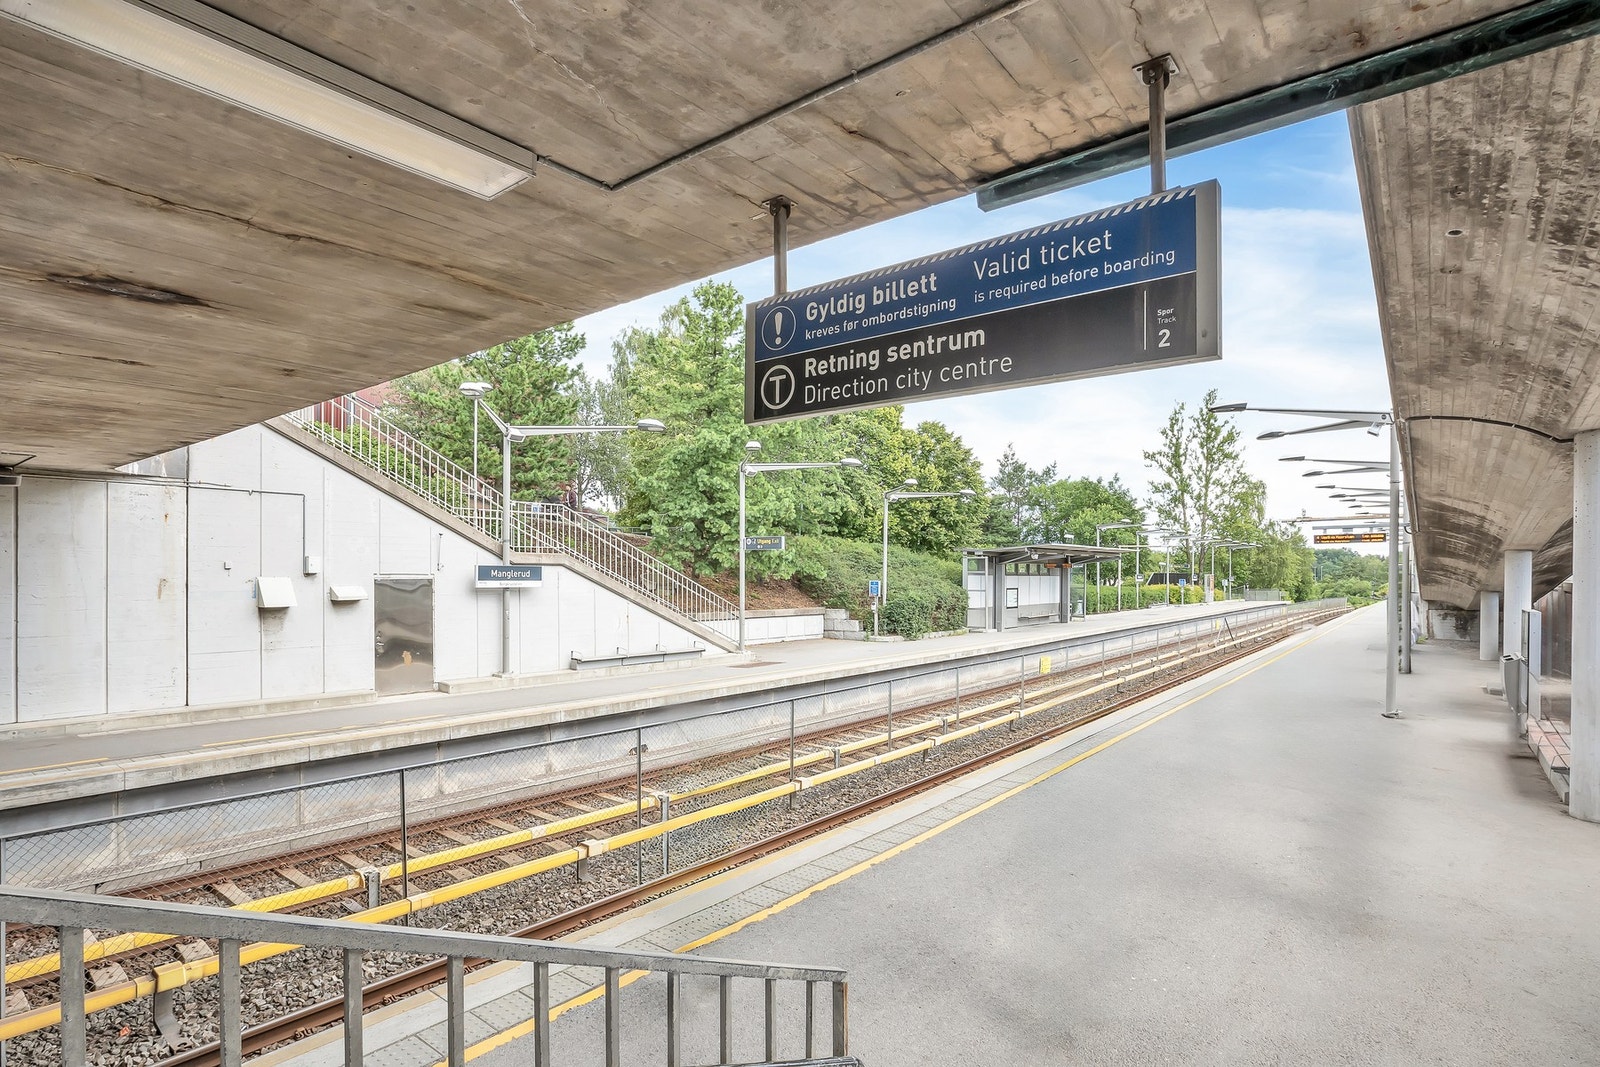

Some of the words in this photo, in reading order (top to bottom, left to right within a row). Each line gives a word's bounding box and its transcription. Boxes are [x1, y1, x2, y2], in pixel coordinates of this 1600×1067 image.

[973, 247, 1030, 281] Valid
[1040, 229, 1112, 265] ticket
[974, 290, 985, 303] is
[989, 275, 1047, 299] required
[1051, 266, 1099, 287] before
[1104, 250, 1175, 275] boarding
[805, 325, 840, 340] kreves
[843, 320, 859, 331] før
[862, 297, 956, 328] ombordstigning
[806, 292, 866, 323] Gyldig
[873, 272, 937, 306] billett
[1157, 308, 1174, 317] Spor
[1158, 316, 1177, 325] Track
[805, 349, 880, 378] Retning
[887, 329, 985, 363] sentrum
[1158, 328, 1171, 348] 2
[804, 376, 888, 405] Direction
[896, 367, 932, 391] city
[940, 356, 1013, 383] centre
[490, 569, 531, 580] Manglerud
